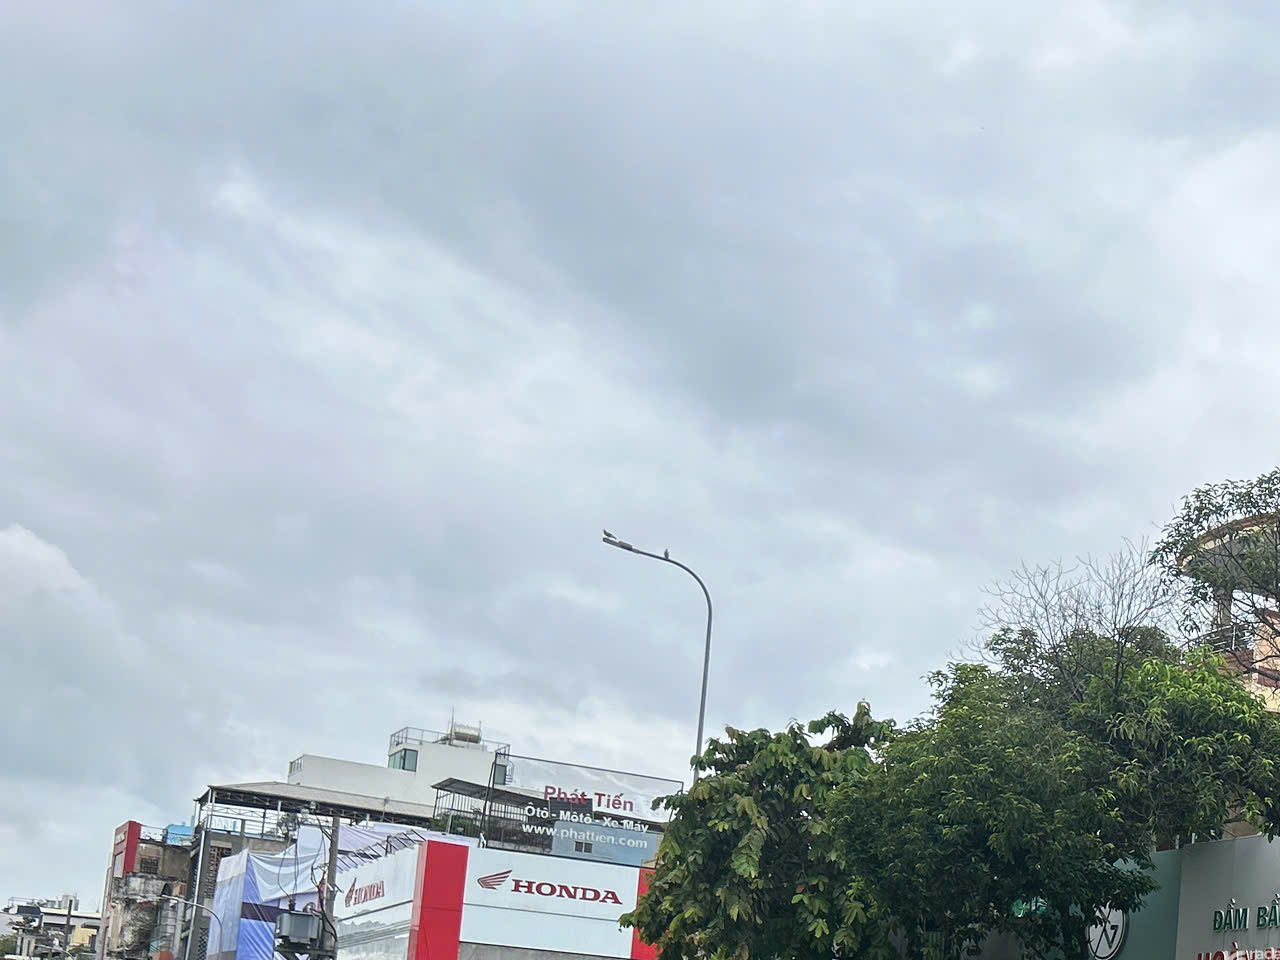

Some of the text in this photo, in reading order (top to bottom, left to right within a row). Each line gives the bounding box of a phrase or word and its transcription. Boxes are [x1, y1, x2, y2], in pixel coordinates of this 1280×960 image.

[544, 785, 633, 811] Phát Tiến
[353, 880, 385, 906] HONDA
[511, 879, 622, 905] HONDA
